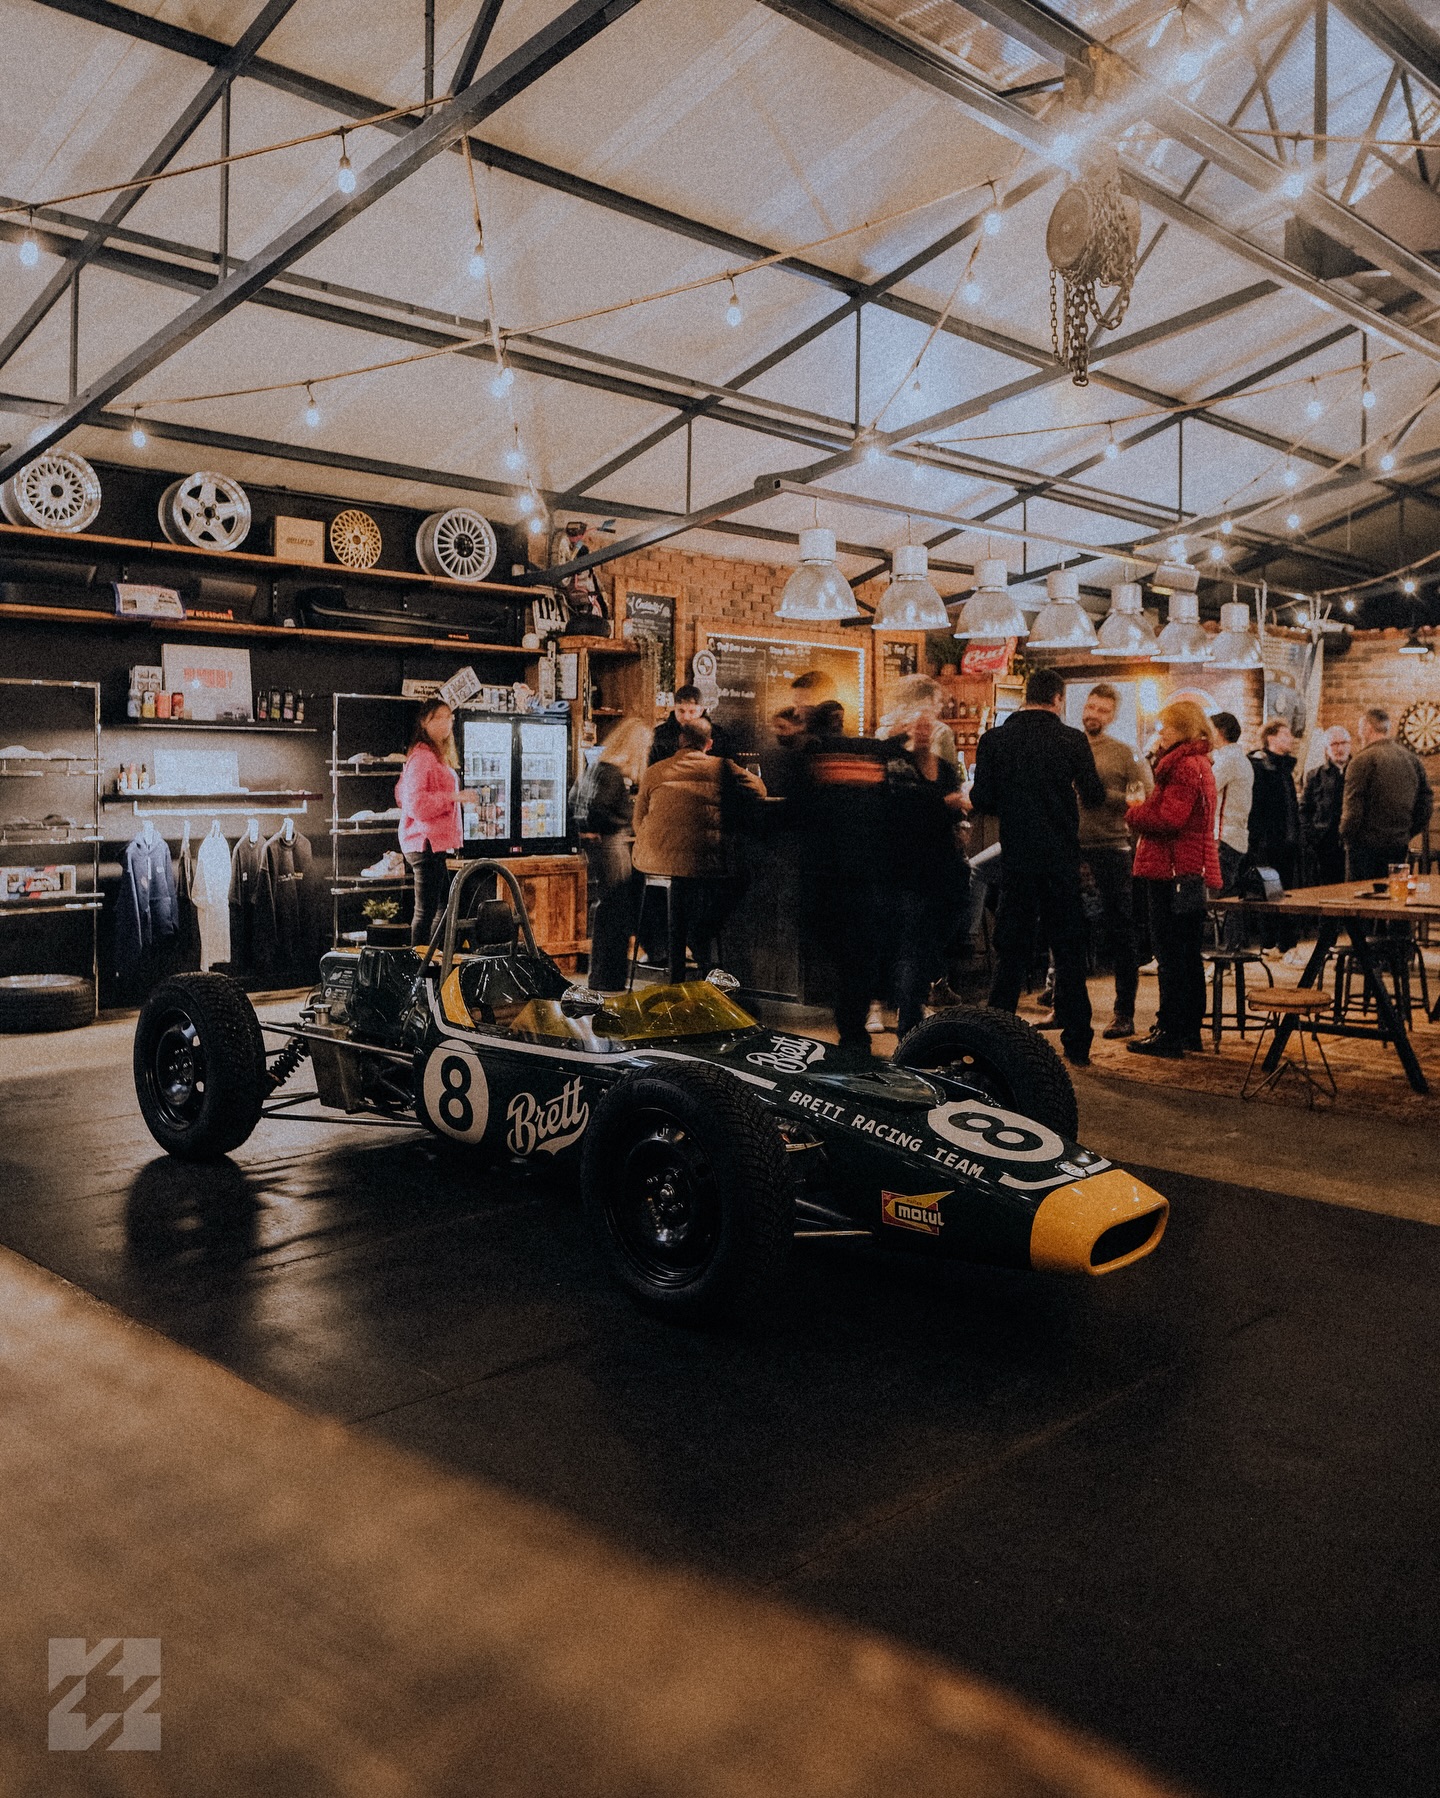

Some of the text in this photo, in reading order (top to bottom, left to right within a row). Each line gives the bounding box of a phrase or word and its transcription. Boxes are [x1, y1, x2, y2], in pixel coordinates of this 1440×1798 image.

[746, 1035, 825, 1073] Brett
[438, 1055, 474, 1132] 8
[506, 1075, 590, 1156] Brett
[788, 1090, 986, 1179] BRETT RACING TEAM
[948, 1111, 1044, 1152] 8
[898, 1205, 945, 1227] motul
